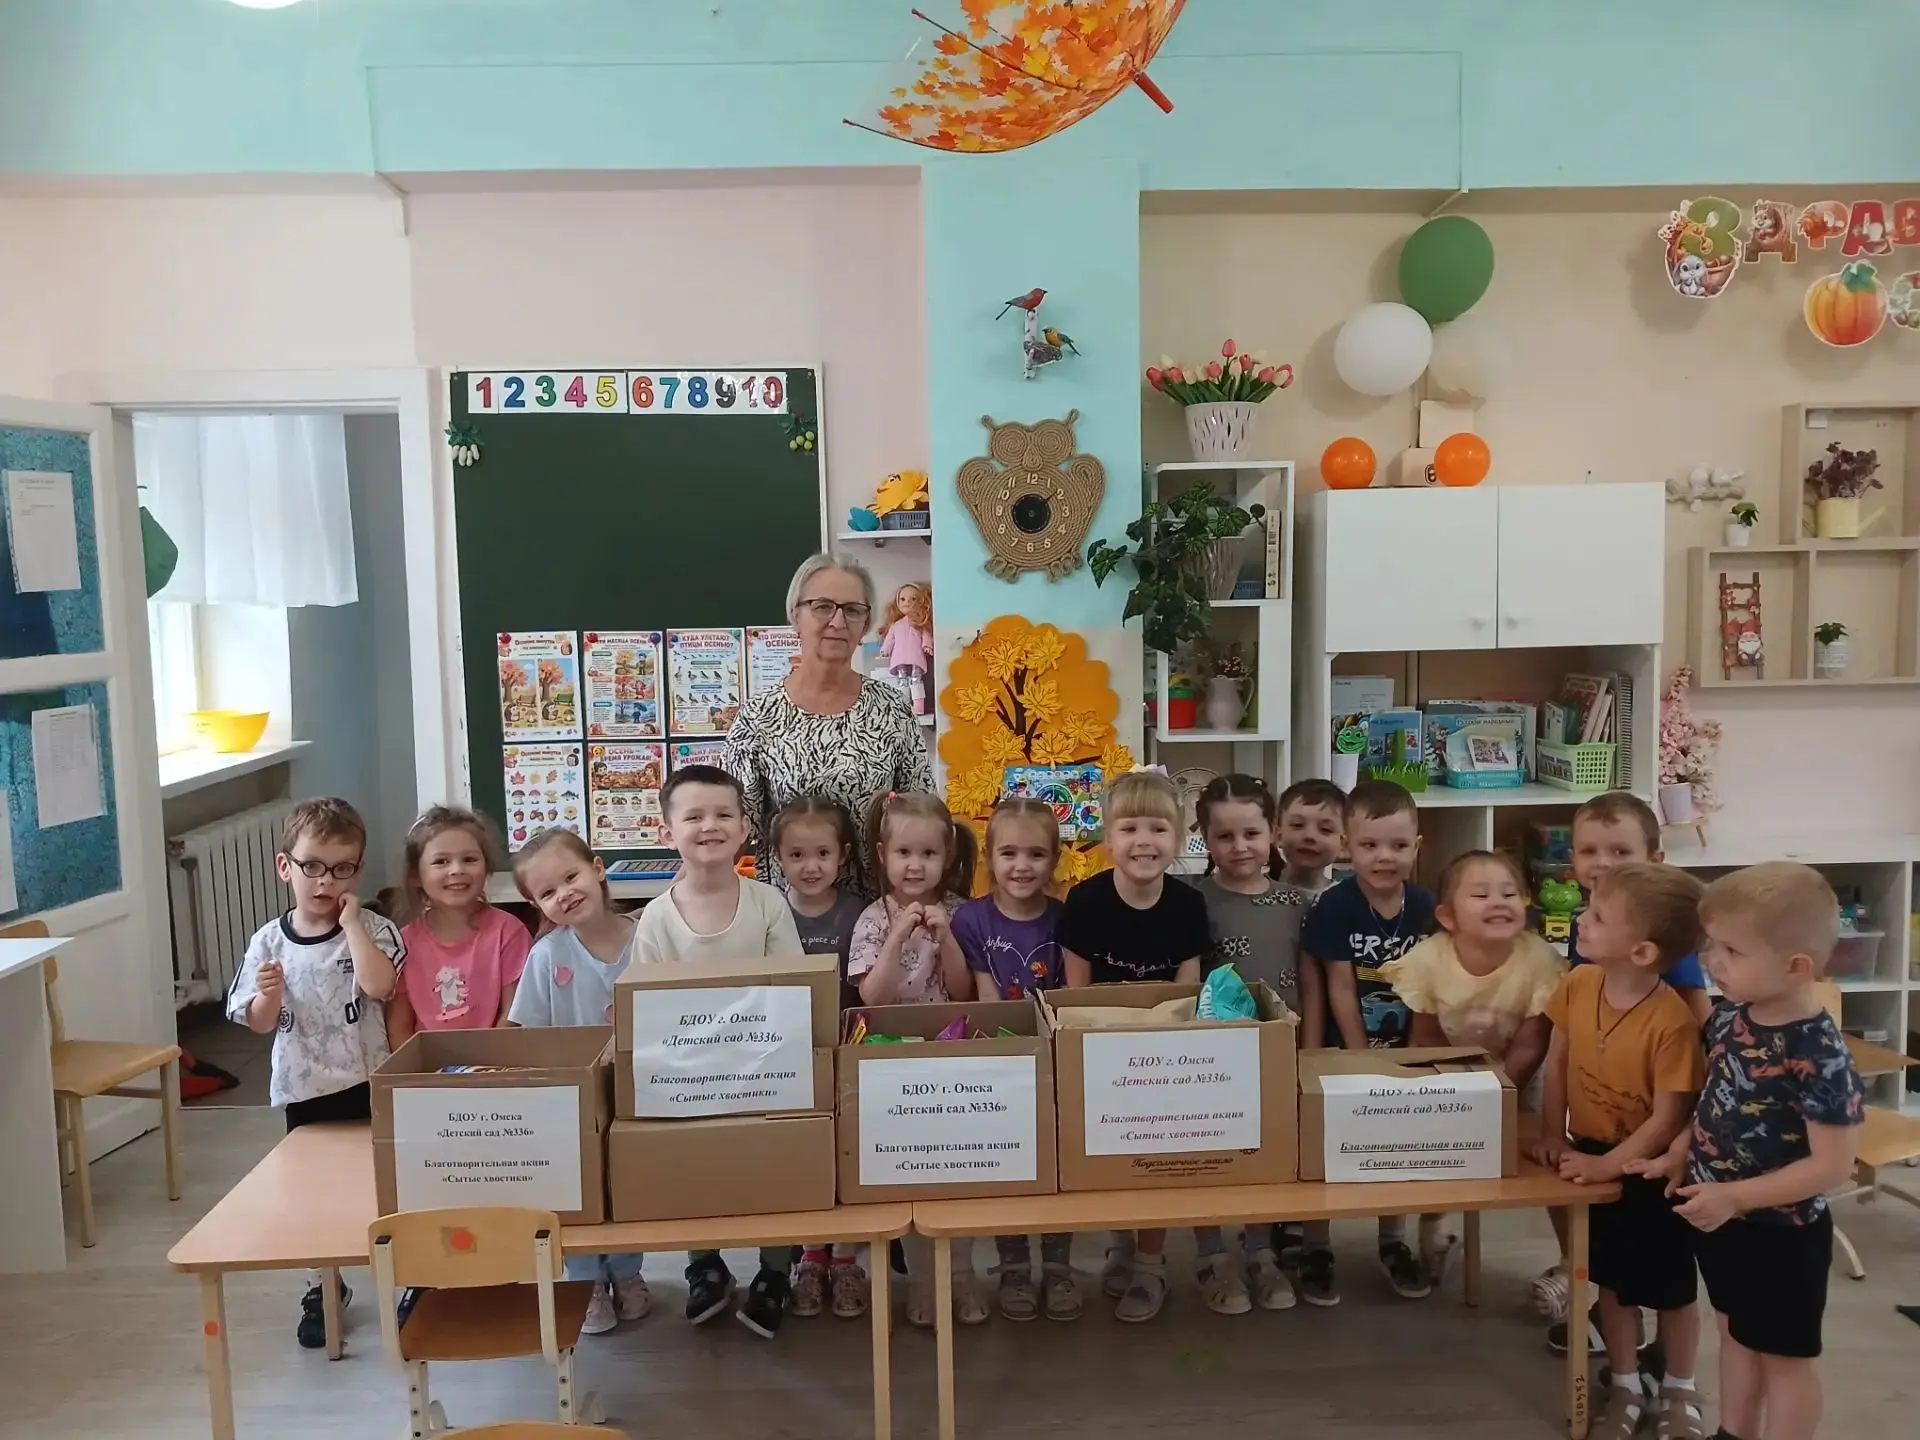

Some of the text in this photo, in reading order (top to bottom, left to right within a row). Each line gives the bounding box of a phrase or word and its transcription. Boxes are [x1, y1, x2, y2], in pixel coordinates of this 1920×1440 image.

[476, 375, 618, 409] 1 2 3 4 5
[632, 376, 784, 409] 6 7 8 9 10
[679, 1013, 767, 1026] БДОУ г. Омска
[662, 1032, 783, 1047] «Детский сад №336»
[1128, 1055, 1215, 1068] БДОУ г. Омска
[650, 1070, 796, 1085] Благотворительная акция
[1112, 1072, 1232, 1087] «Детский сад №336»
[669, 1089, 778, 1103] «Сытые хвостики»
[902, 1083, 993, 1096] БДОУ г. Омска
[887, 1102, 1007, 1116] «Детский сад №336»
[1352, 1102, 1473, 1116] «Детский сад №336»
[448, 1113, 478, 1122] БДОУ
[490, 1113, 522, 1121] Омска
[1100, 1111, 1244, 1124] Благотворительная акция
[437, 1128, 535, 1138] «Детский сад №336»
[1120, 1129, 1226, 1141] «Сытые хвостики»
[875, 1142, 1020, 1154] Благотворительная акция
[1340, 1139, 1485, 1153] Благотворительная акция
[424, 1159, 550, 1169] Благотворительная акция
[895, 1160, 1001, 1171] «Сытые хвостики»
[1359, 1156, 1466, 1169] «Сытые хвостики»
[442, 1174, 533, 1183] «Сытые хвостики»
